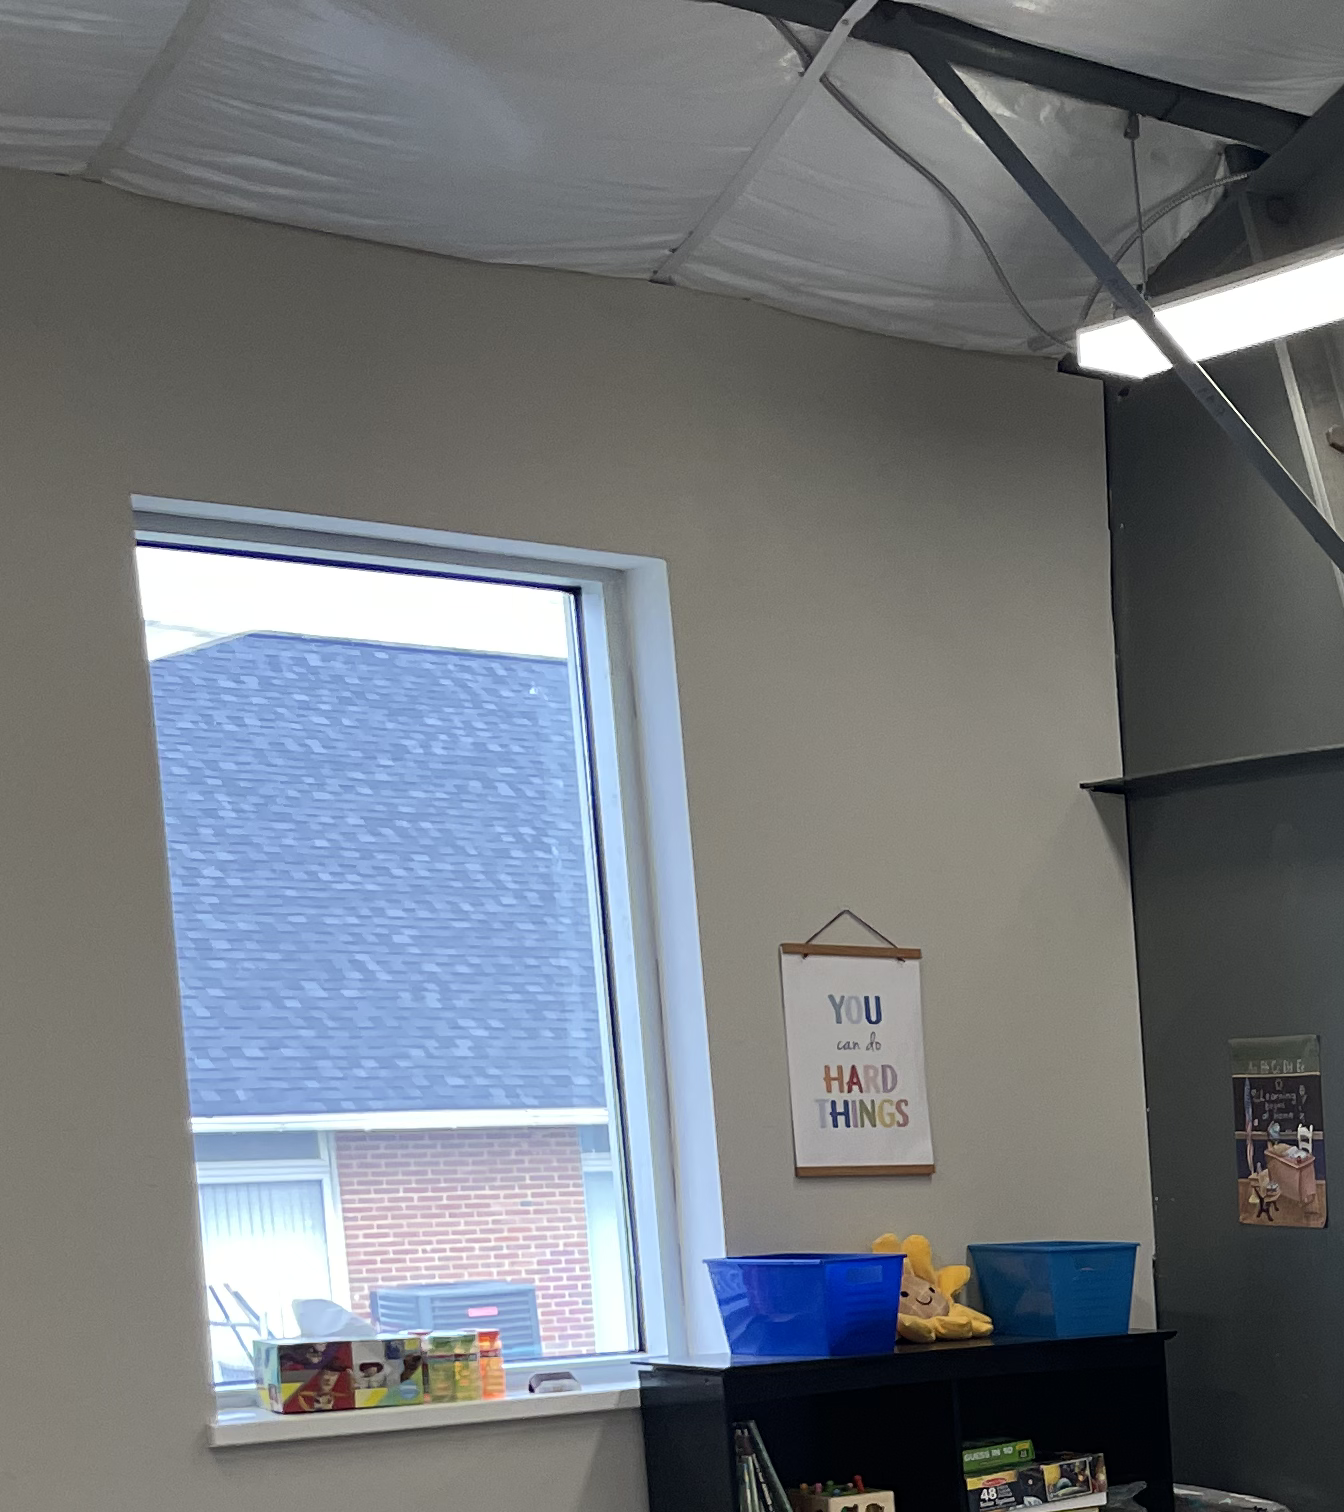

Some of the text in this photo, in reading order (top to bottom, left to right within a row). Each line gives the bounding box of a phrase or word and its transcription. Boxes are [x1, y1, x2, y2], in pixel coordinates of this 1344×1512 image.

[827, 994, 883, 1025] YOU
[836, 1031, 882, 1052] can do
[823, 1064, 898, 1094] HARD
[815, 1099, 910, 1129] THINGS
[980, 1487, 997, 1501] 48
